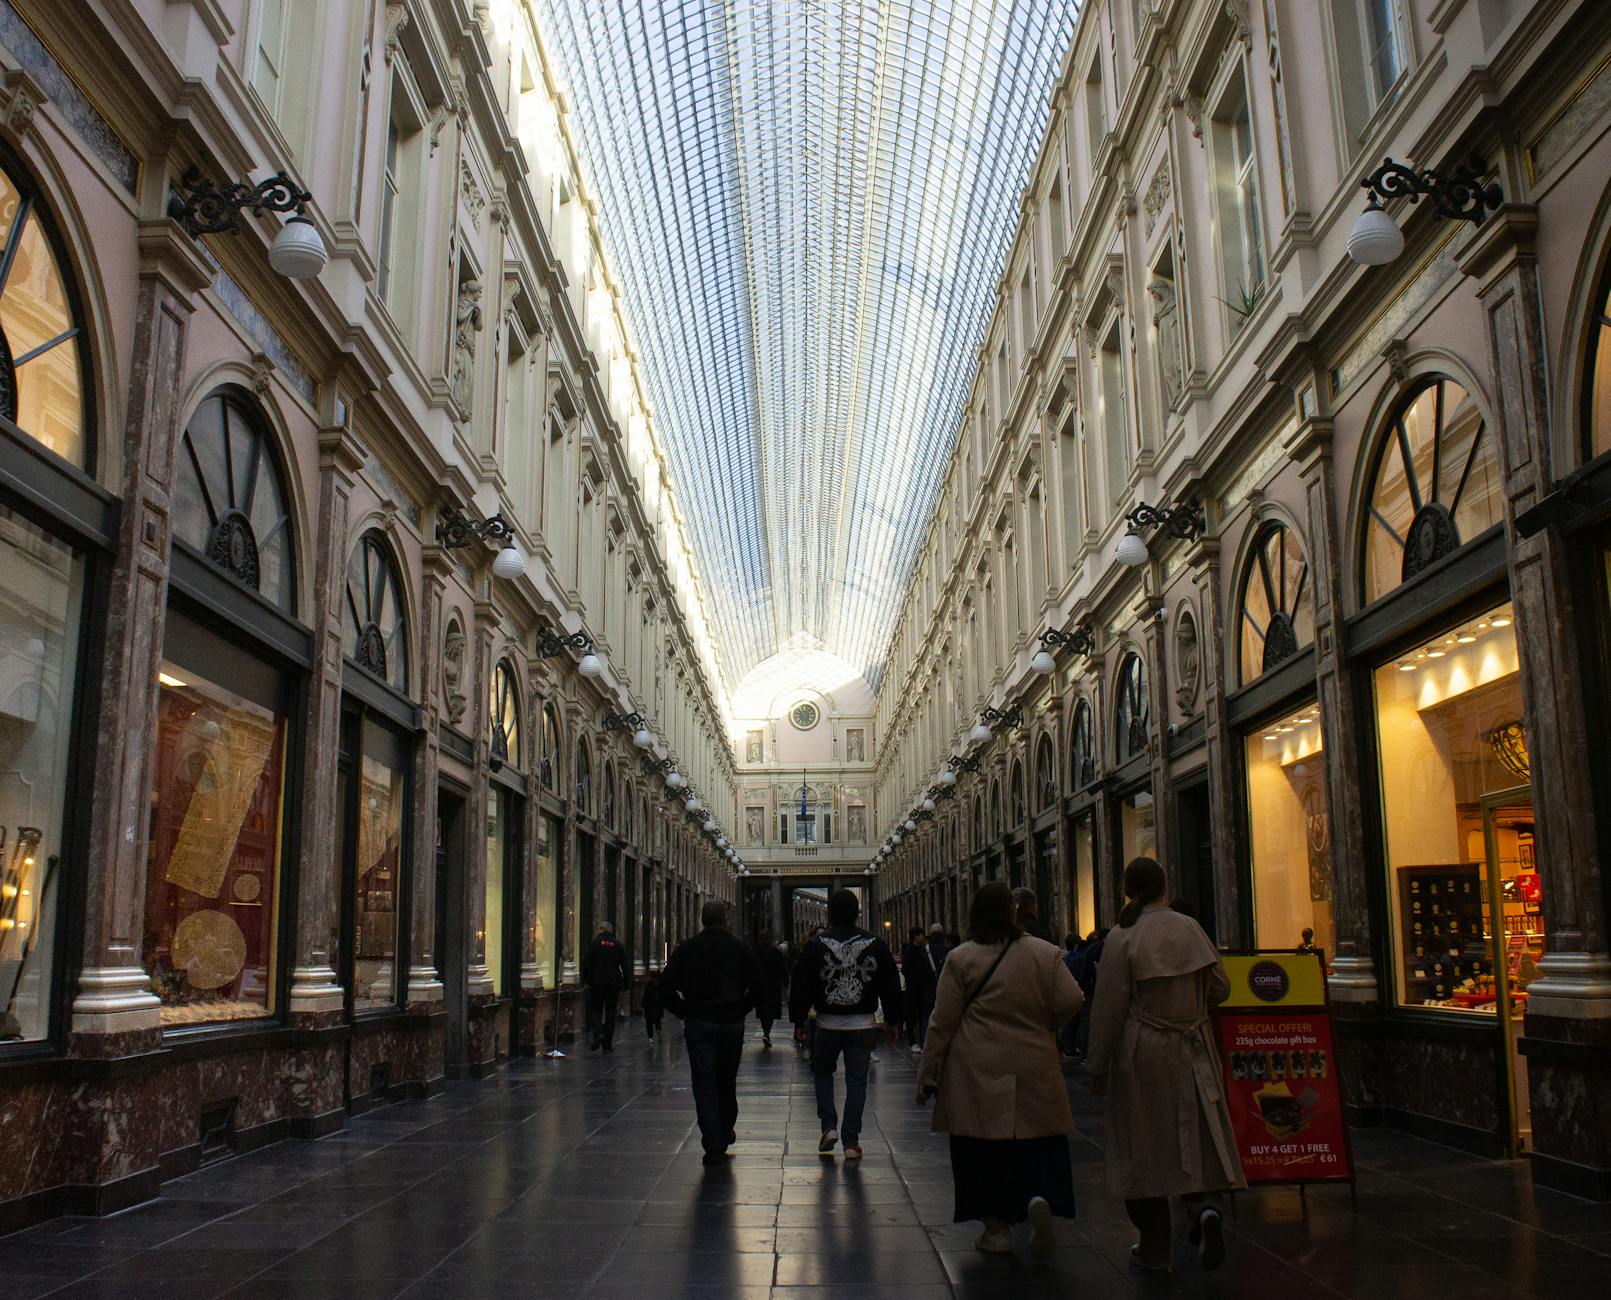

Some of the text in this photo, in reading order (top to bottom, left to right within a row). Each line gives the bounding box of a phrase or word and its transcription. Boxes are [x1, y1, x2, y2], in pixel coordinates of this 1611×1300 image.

[1238, 1022, 1313, 1034] SPECIAL OFFER!
[1235, 1034, 1317, 1047] 235g chocolate gift box
[1250, 1143, 1329, 1154] BUY 4 GET 1 FREE
